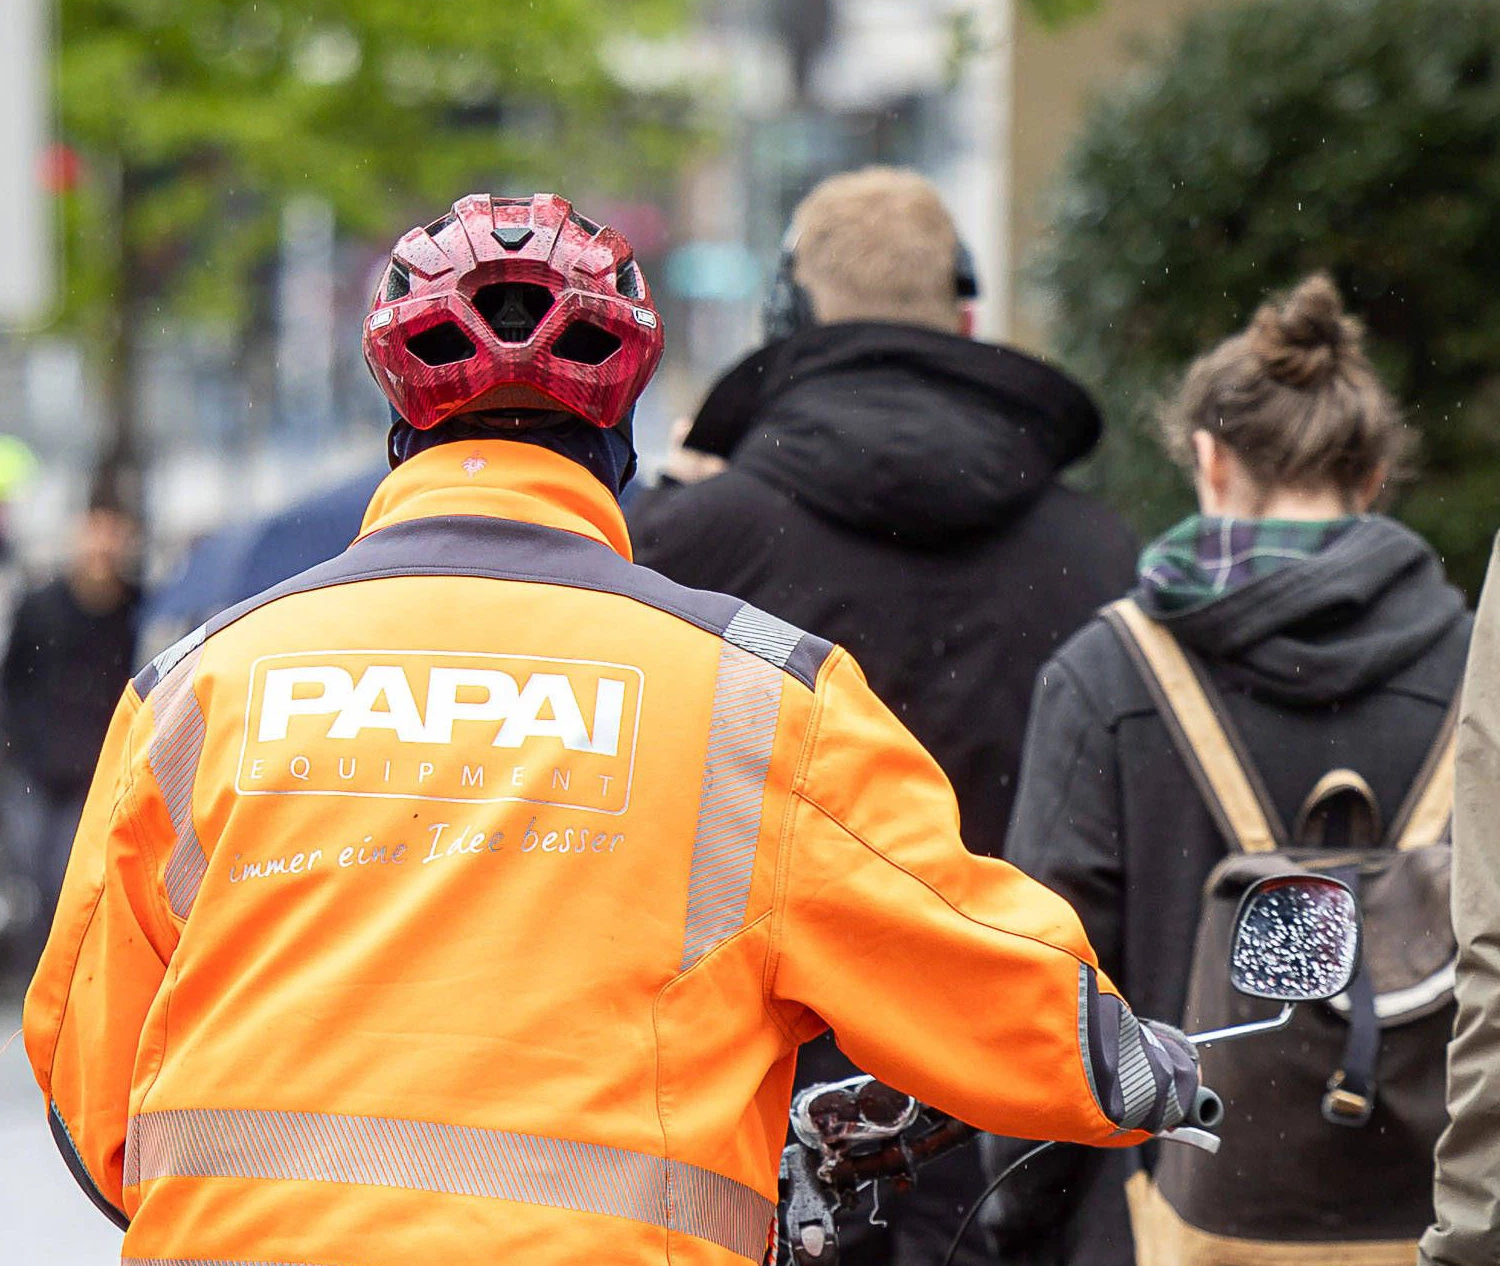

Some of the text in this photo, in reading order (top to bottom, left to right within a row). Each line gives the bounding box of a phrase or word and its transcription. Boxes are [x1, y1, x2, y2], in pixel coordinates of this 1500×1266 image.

[258, 665, 626, 757] PAPAI
[250, 755, 613, 797] EQUIPMENT
[229, 815, 625, 883] immer eine Idee besser
